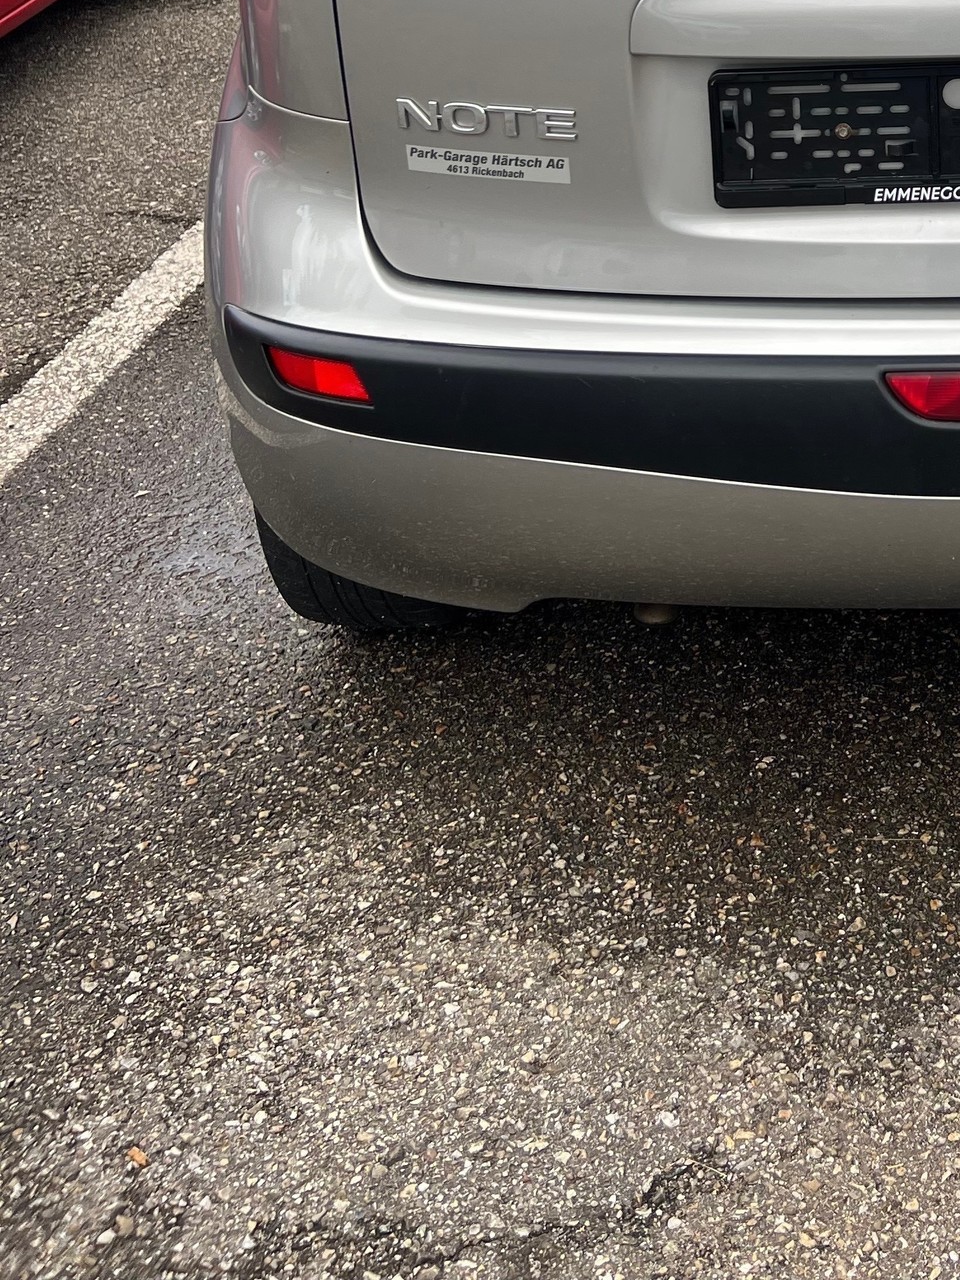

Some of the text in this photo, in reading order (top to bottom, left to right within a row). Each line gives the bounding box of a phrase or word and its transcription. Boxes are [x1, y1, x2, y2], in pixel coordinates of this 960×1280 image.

[396, 96, 578, 141] NOTE
[409, 147, 565, 170] Park-Garage Härtsch AG
[446, 164, 525, 179] 4613 Rickenbach
